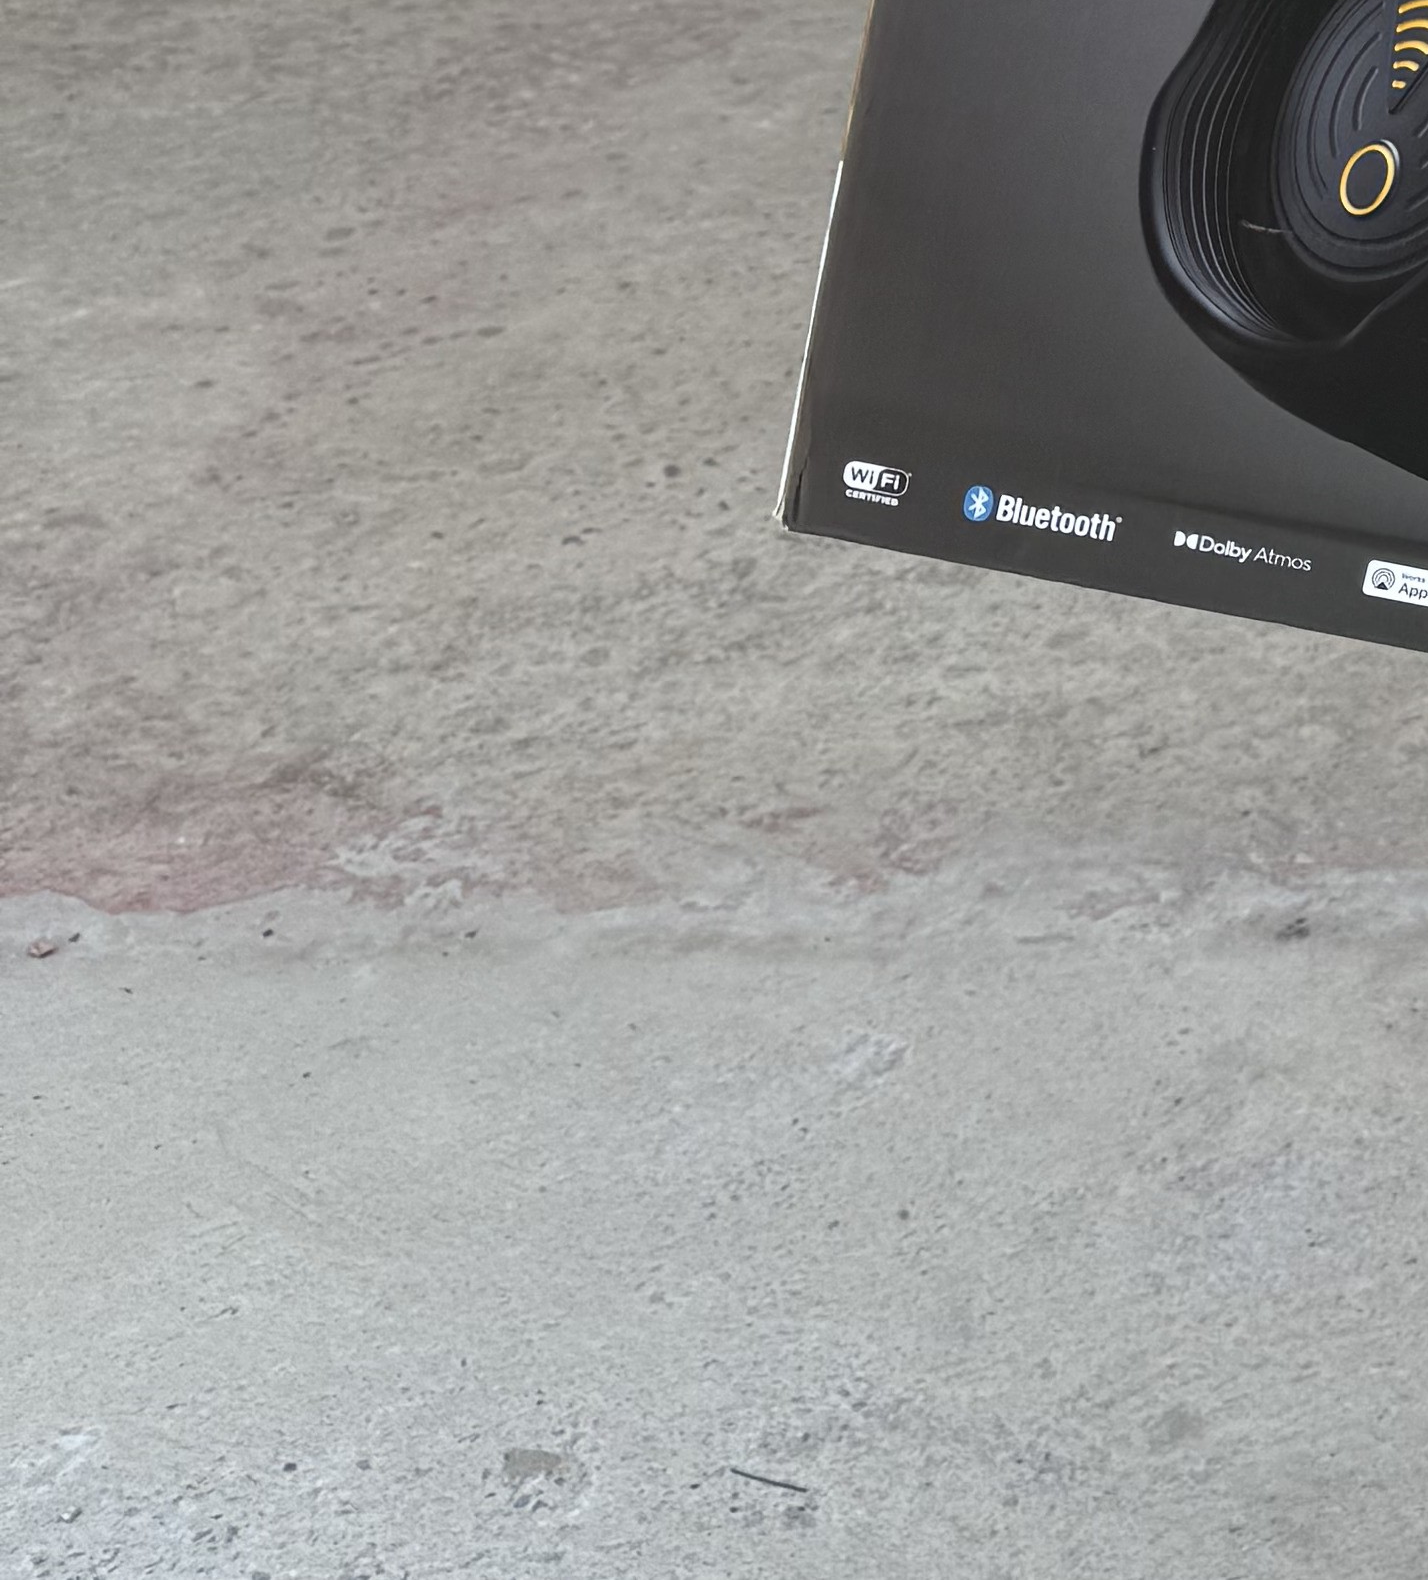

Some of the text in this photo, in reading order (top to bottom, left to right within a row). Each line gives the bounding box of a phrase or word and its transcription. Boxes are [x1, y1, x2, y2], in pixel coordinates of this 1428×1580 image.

[996, 494, 1117, 542] Bluetooth
[1199, 535, 1312, 572] Dolby Atmos
